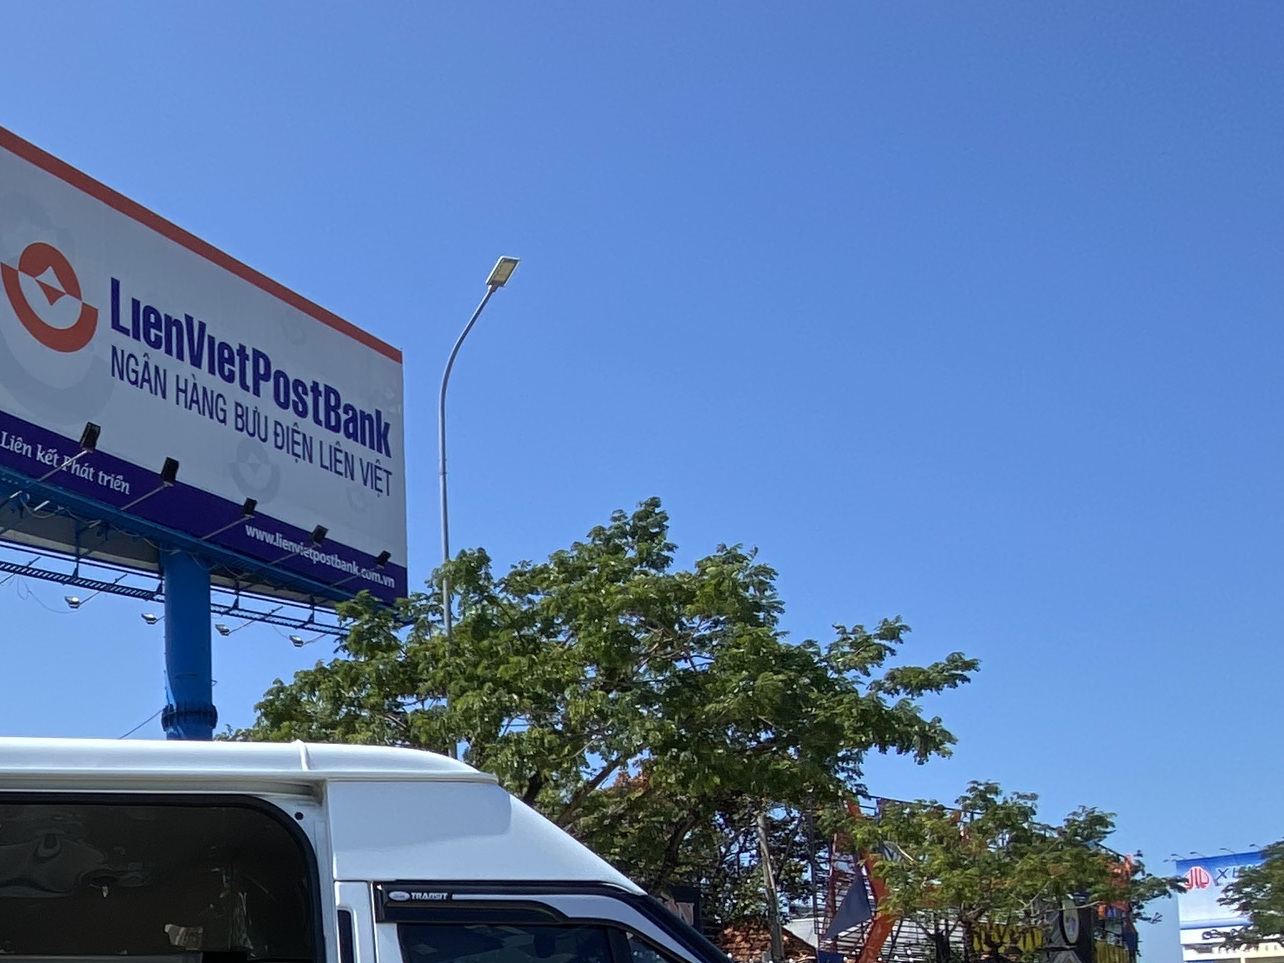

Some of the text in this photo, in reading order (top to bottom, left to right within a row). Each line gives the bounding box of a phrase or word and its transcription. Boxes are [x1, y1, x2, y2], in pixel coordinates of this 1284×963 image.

[111, 277, 392, 459] LienVietPostBank
[111, 344, 393, 497] NGÂN HÀNG BƯU ĐIỆN LIÊN VIỆT
[0, 431, 130, 494] Liên kết Phát triển
[244, 524, 396, 588] www.lienvietpostbank.com.vn
[410, 892, 448, 900] TRANSIT
